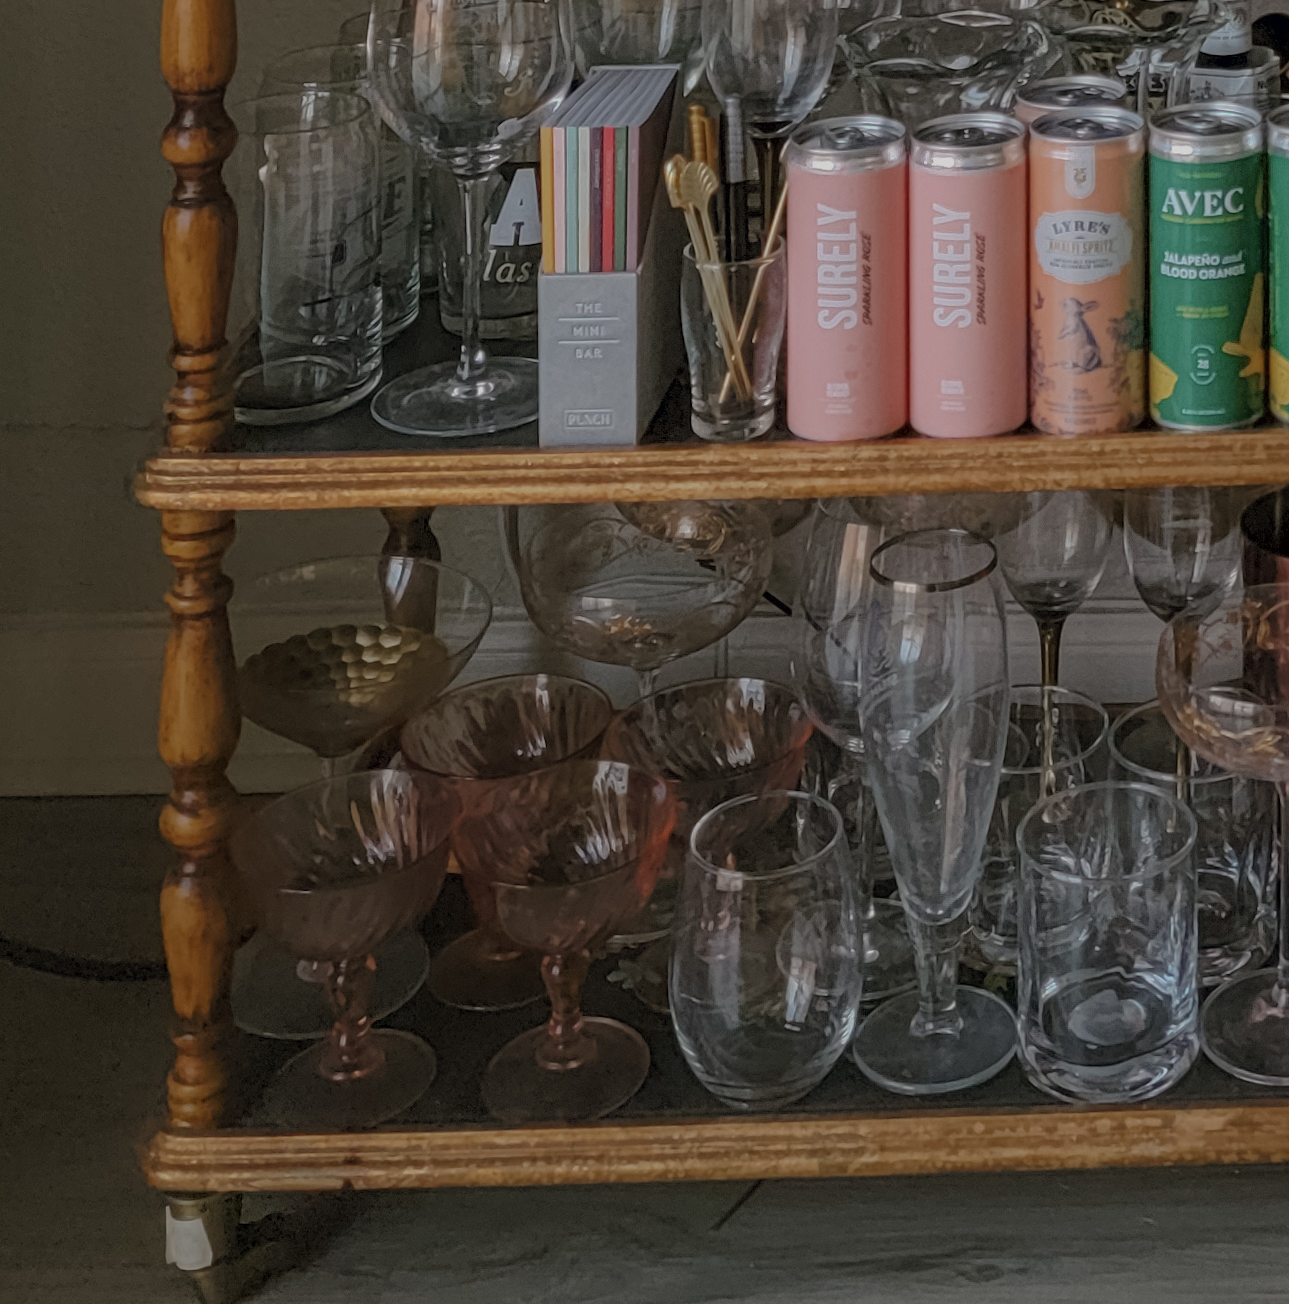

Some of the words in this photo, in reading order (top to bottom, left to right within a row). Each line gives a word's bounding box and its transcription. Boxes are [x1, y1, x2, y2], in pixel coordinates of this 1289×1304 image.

[1162, 187, 1244, 217] AVEC
[1051, 220, 1111, 236] LYRE'S
[1082, 239, 1114, 254] SPRITZ
[817, 202, 858, 330] SURELY
[932, 202, 972, 329] SURELY
[1163, 250, 1220, 266] JALAPEÑO
[1160, 262, 1198, 280] BLOOD
[1198, 263, 1246, 280] ORANGE
[862, 264, 873, 326] SPARKLING
[976, 264, 987, 326] SPARKLING
[575, 303, 603, 313] THE
[572, 325, 605, 337] MINI
[575, 347, 603, 359] BAR
